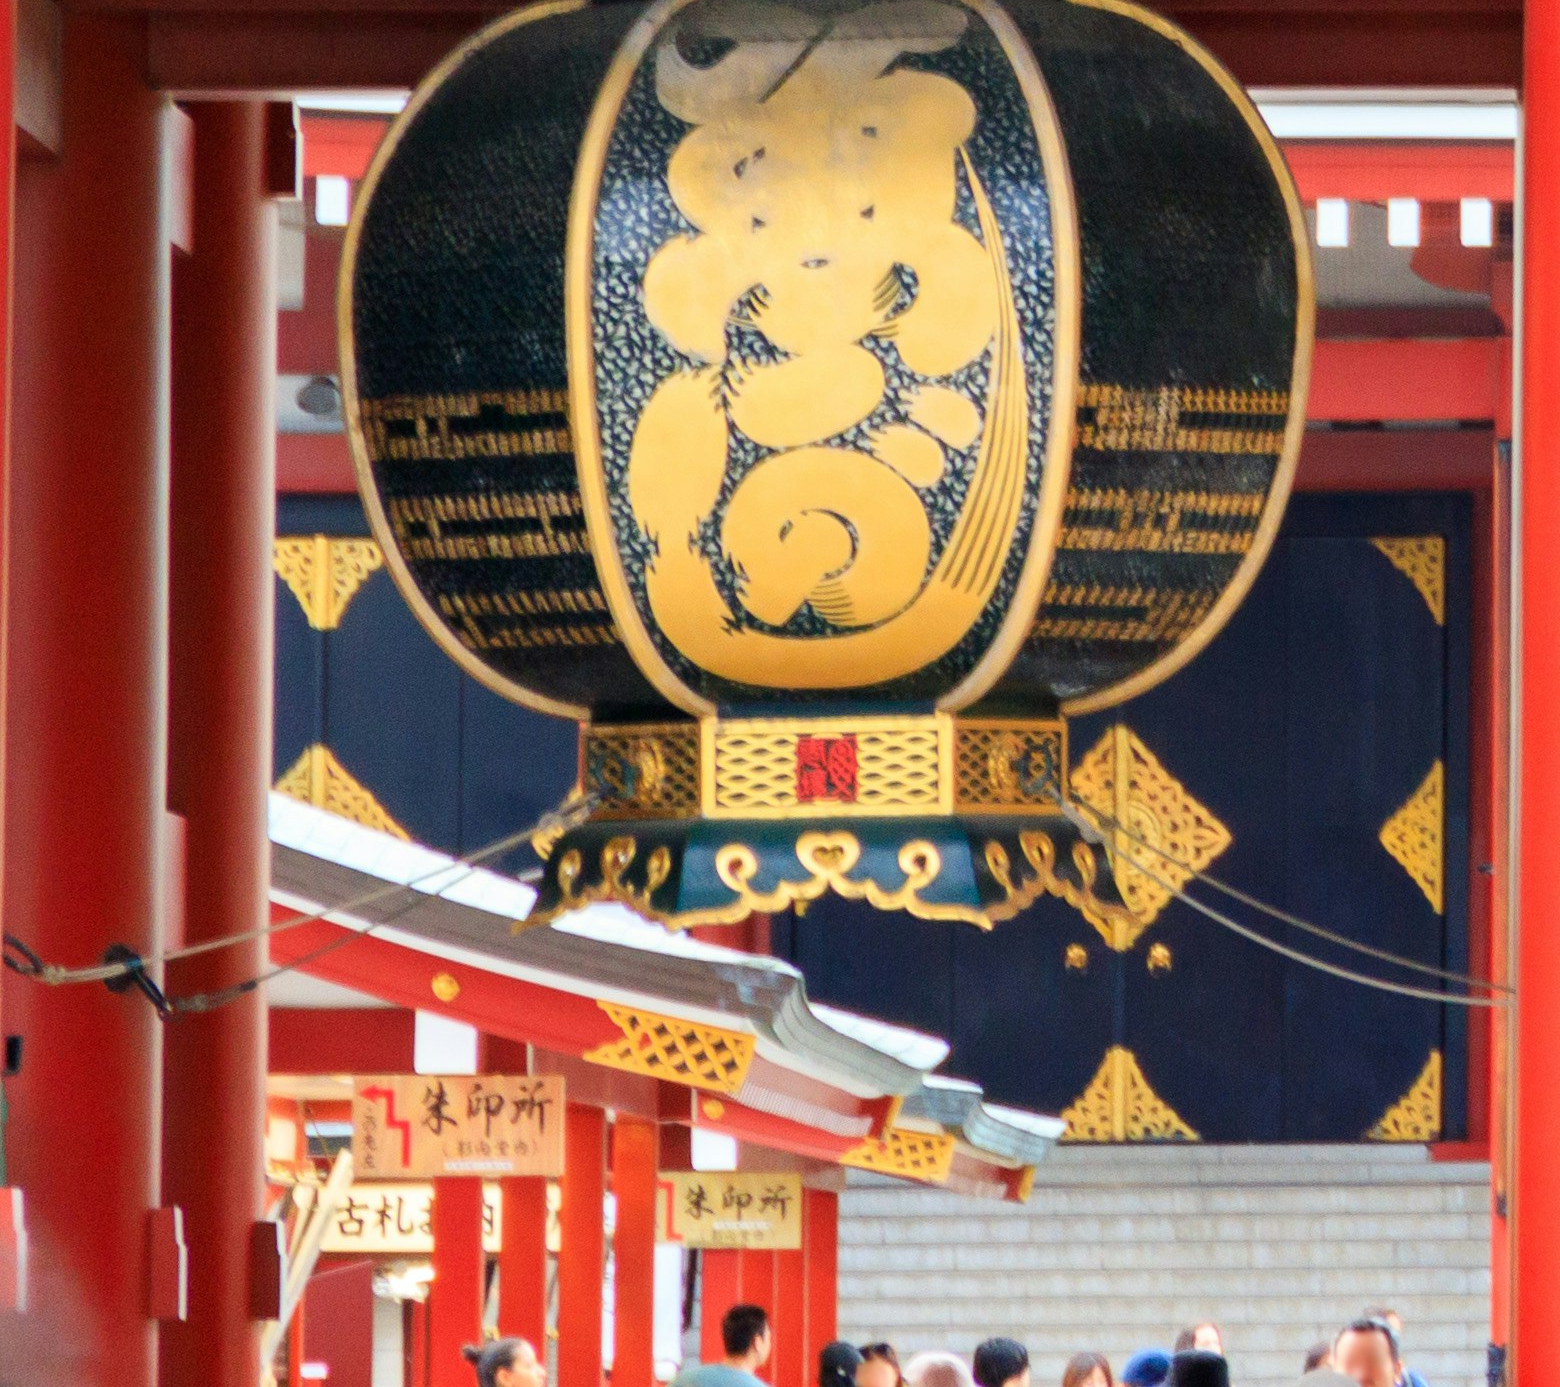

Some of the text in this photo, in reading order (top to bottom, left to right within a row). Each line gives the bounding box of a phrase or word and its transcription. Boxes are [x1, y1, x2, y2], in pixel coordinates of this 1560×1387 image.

[422, 1082, 553, 1138] 朱印所
[685, 1184, 792, 1221] 朱印所
